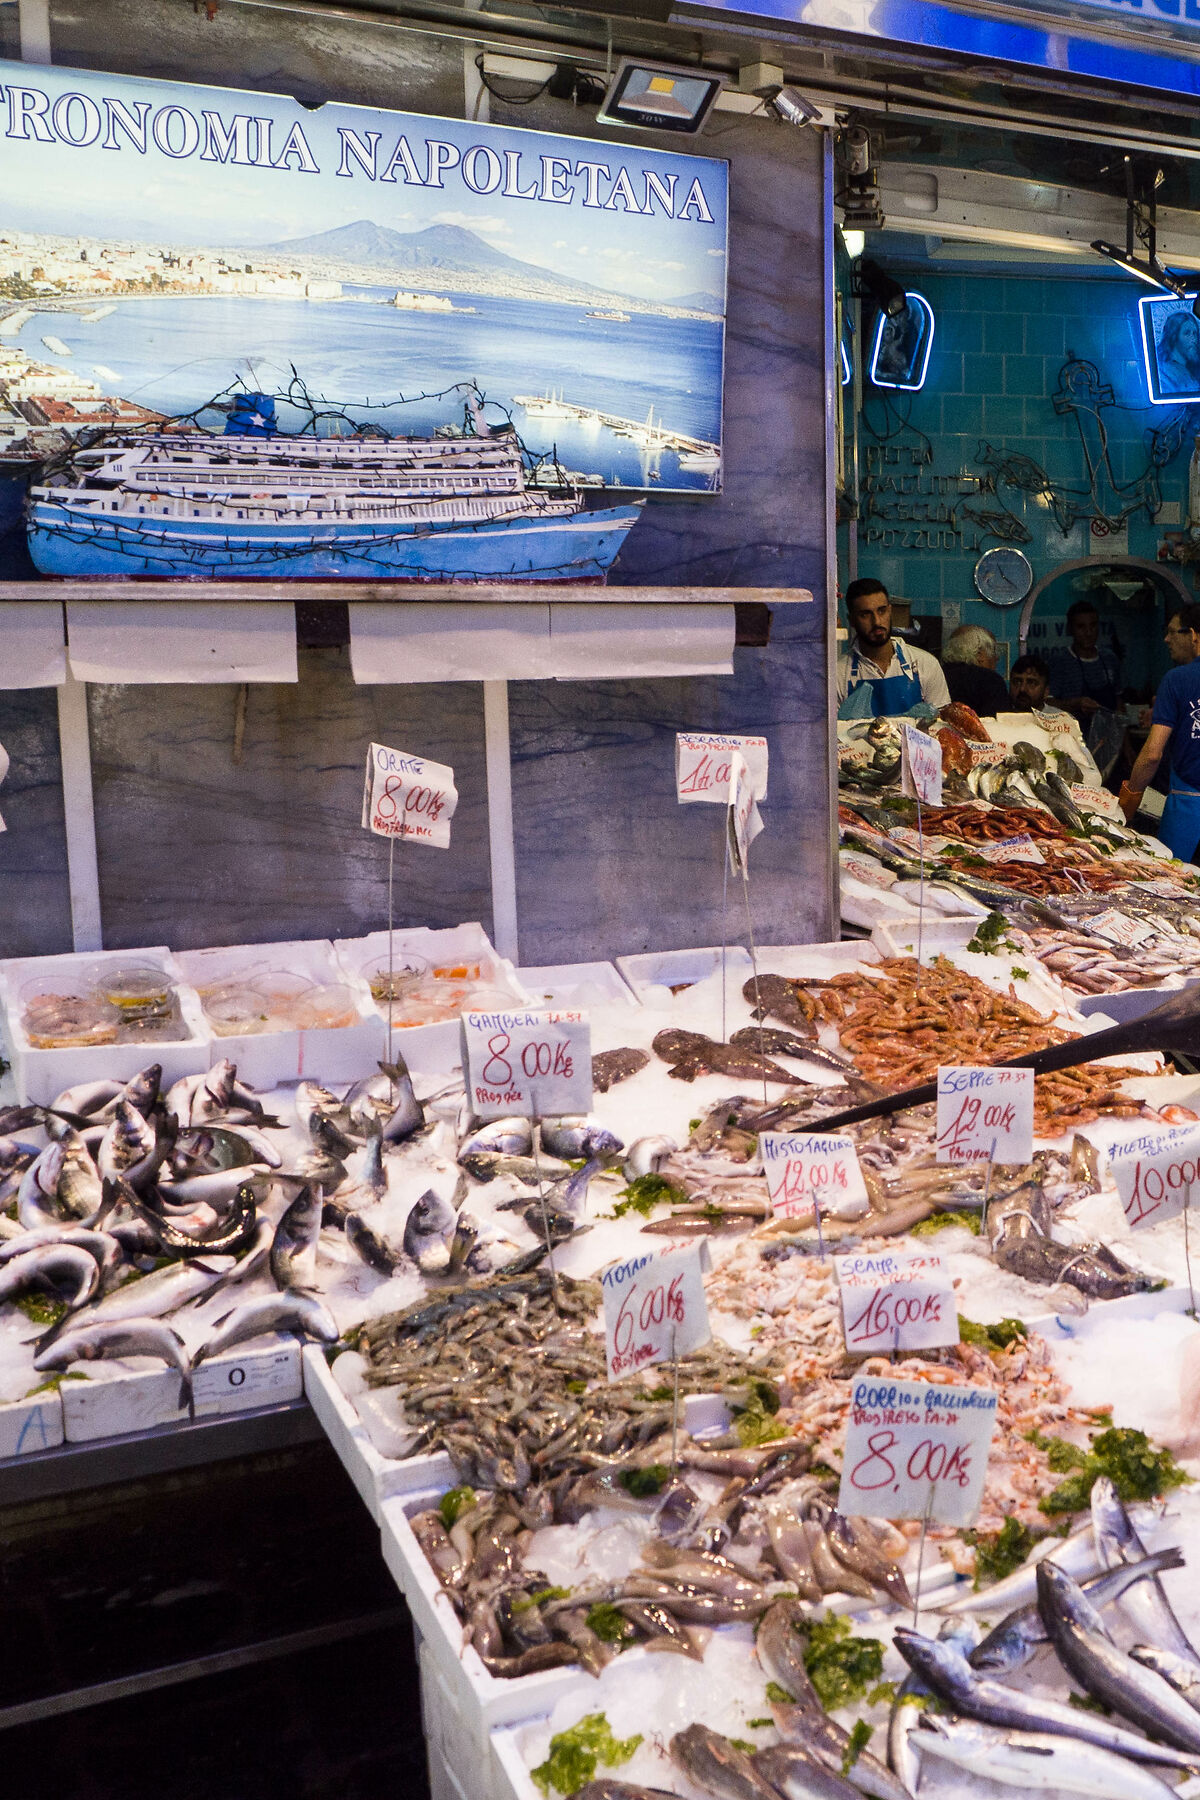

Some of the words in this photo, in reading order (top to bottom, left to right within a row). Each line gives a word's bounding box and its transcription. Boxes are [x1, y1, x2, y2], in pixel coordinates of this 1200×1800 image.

[0, 85, 320, 173] RONOMIA
[336, 128, 714, 223] NAPOLETANA
[377, 749, 424, 775] ORATE
[939, 1071, 993, 1094] SEPPIE
